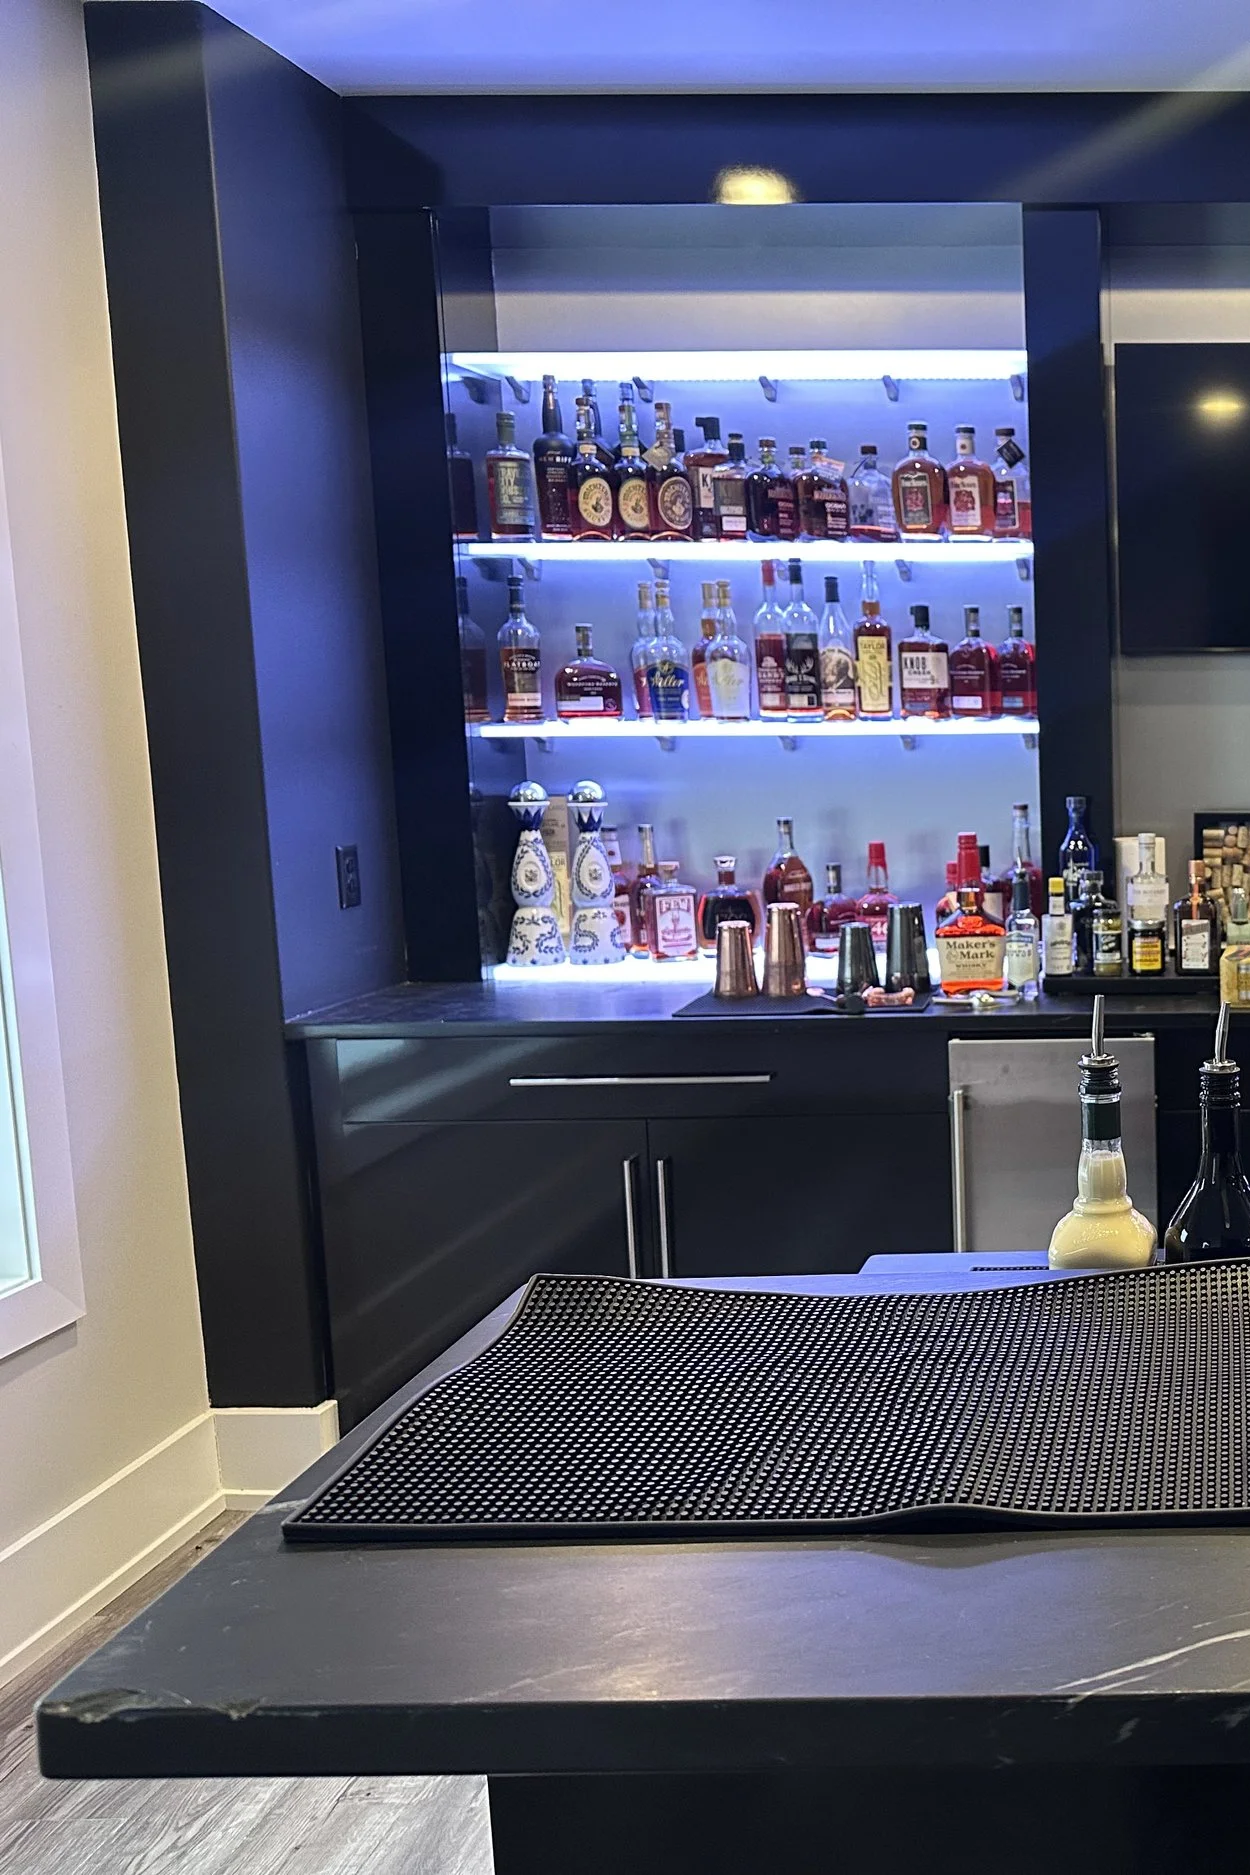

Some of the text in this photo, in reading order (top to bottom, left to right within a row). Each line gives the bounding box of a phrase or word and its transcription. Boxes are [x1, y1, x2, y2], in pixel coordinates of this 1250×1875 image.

[903, 656, 926, 669] KNOB
[946, 940, 996, 949] Maker's
[960, 950, 995, 959] Mark
